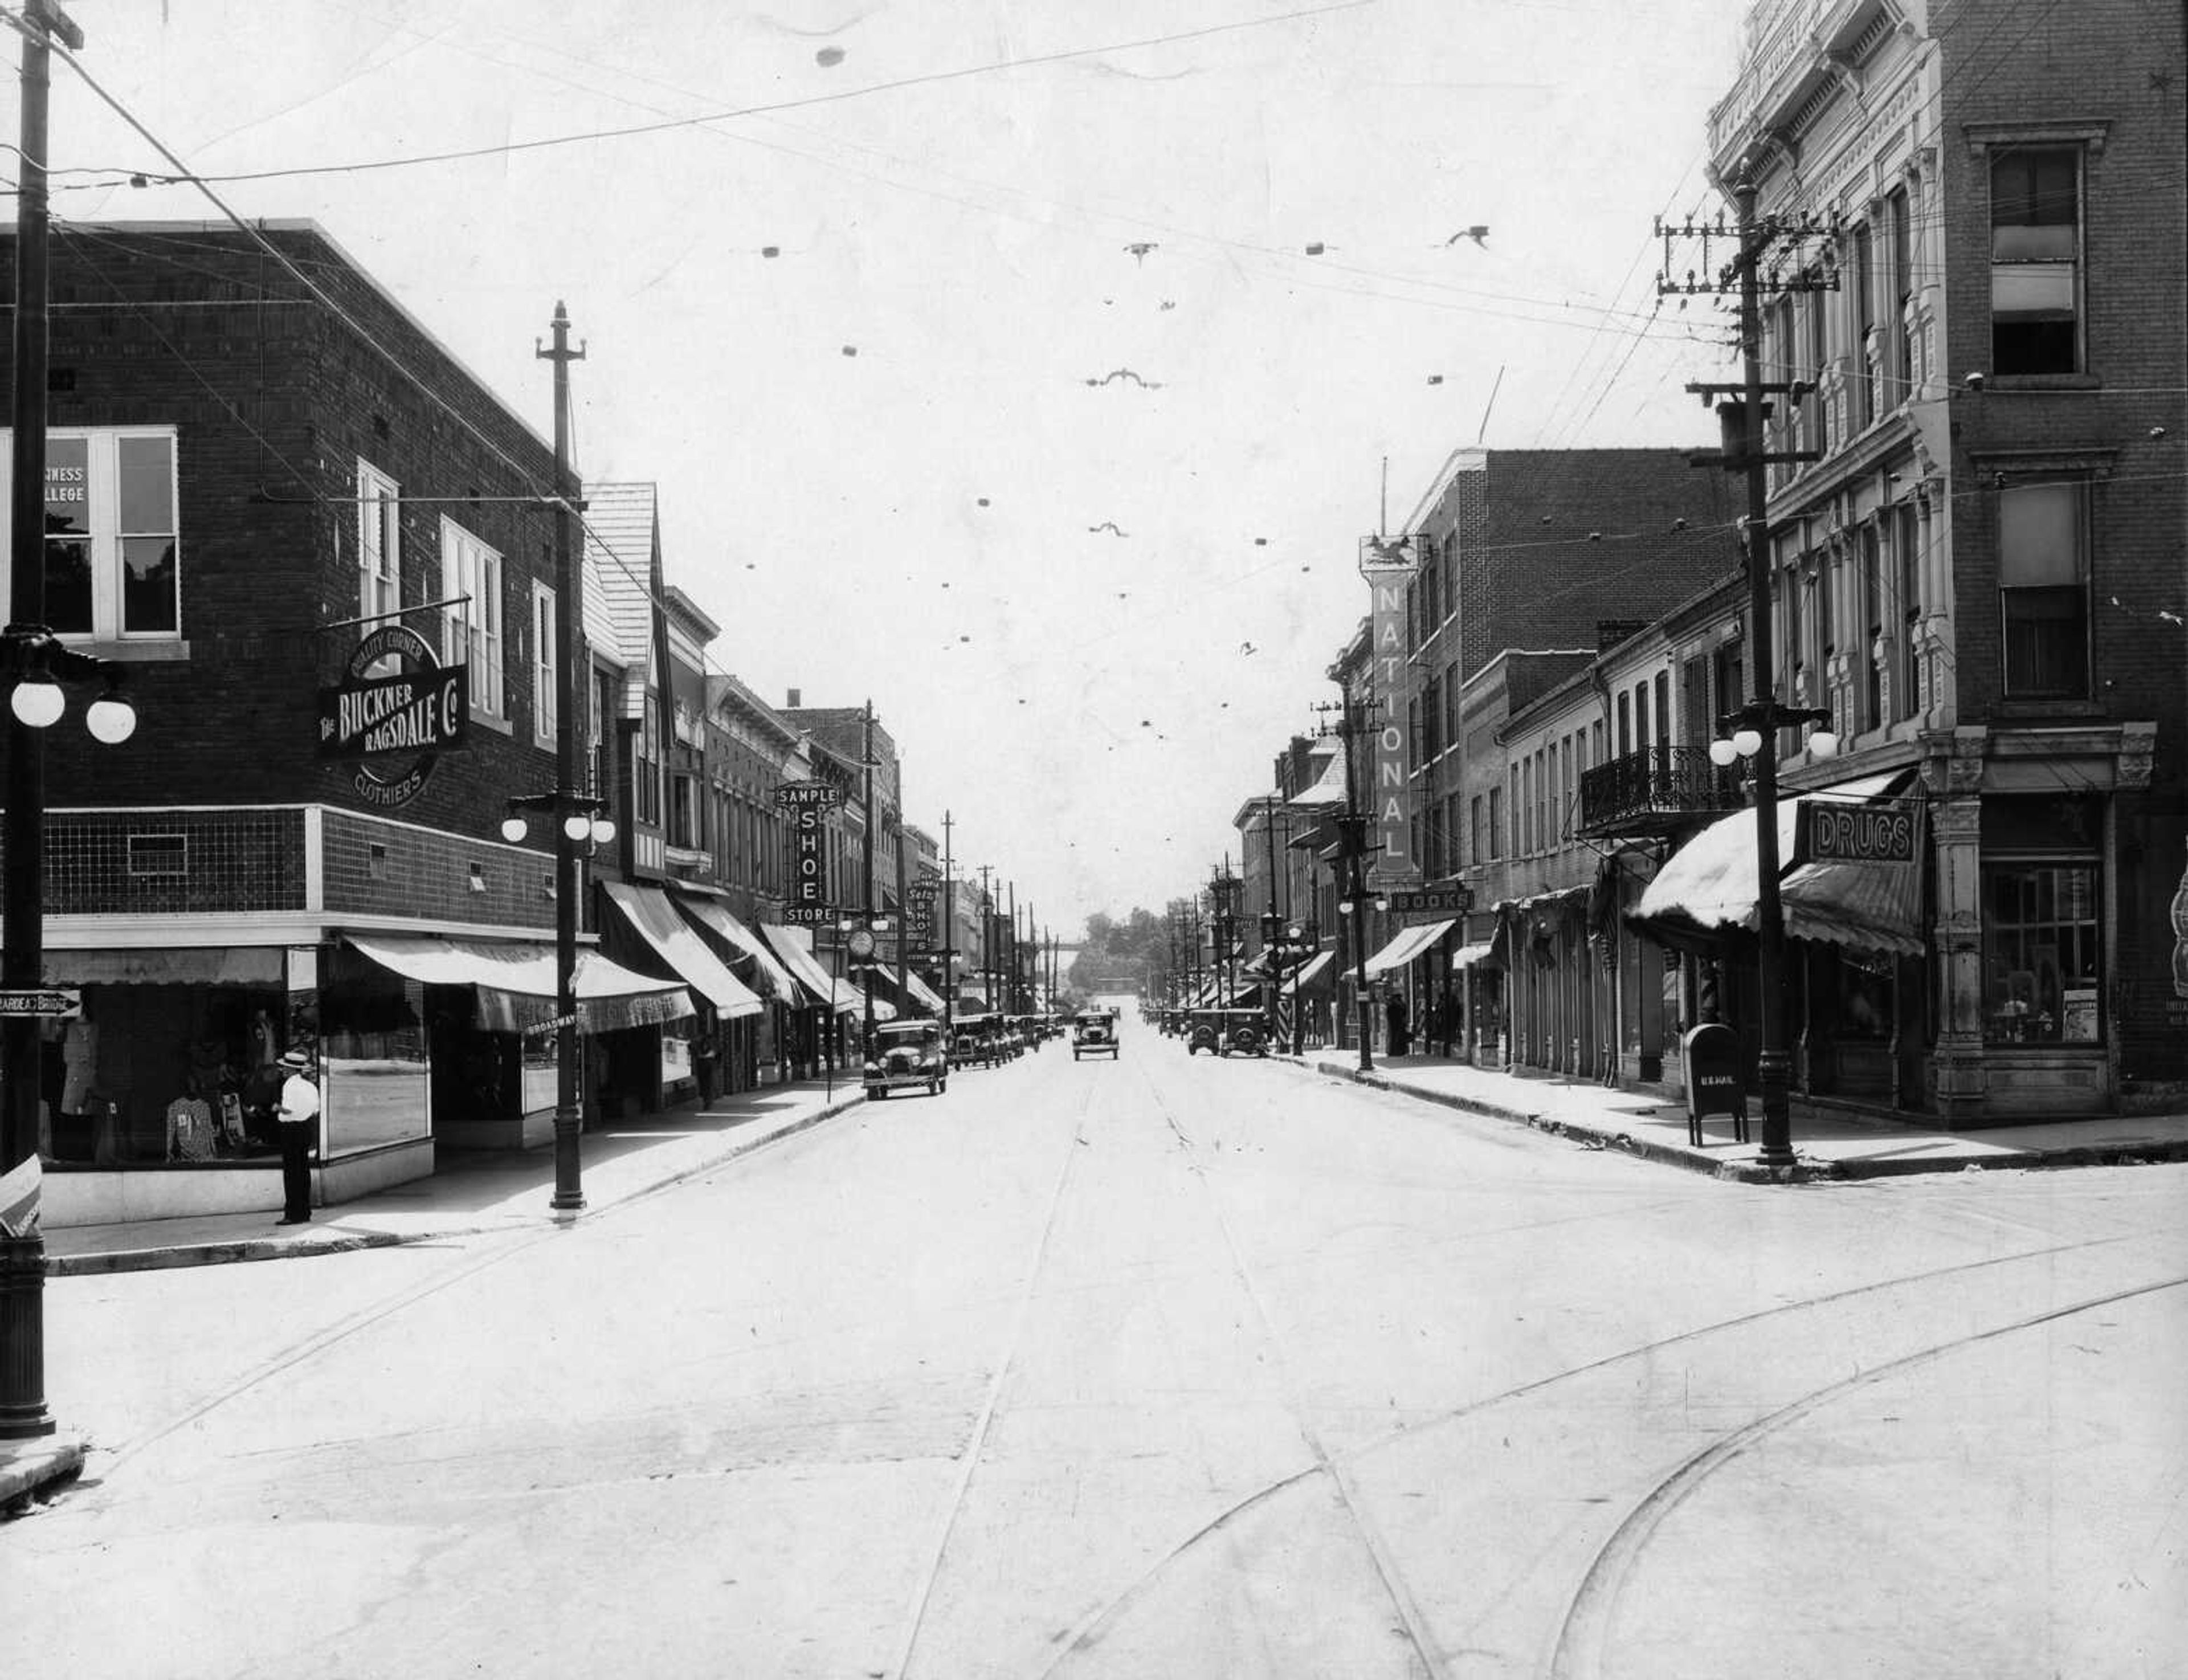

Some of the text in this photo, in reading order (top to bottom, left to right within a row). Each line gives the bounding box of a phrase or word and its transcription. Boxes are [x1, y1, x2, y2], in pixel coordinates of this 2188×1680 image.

[387, 631, 423, 662] CORNER
[340, 683, 413, 741] BUCKNER
[365, 692, 436, 752] RAGSDALE
[1380, 587, 1403, 857] NATIONAL
[354, 770, 422, 805] CLOTHIERS
[778, 789, 836, 803] SAMPLE
[1816, 812, 1911, 855] DRUGS
[801, 811, 817, 900] SHOE
[786, 908, 835, 921] STORE
[1397, 894, 1468, 908] BOOKS
[0, 997, 37, 1010] ARDEAU
[527, 1014, 575, 1035] BROADWAY
